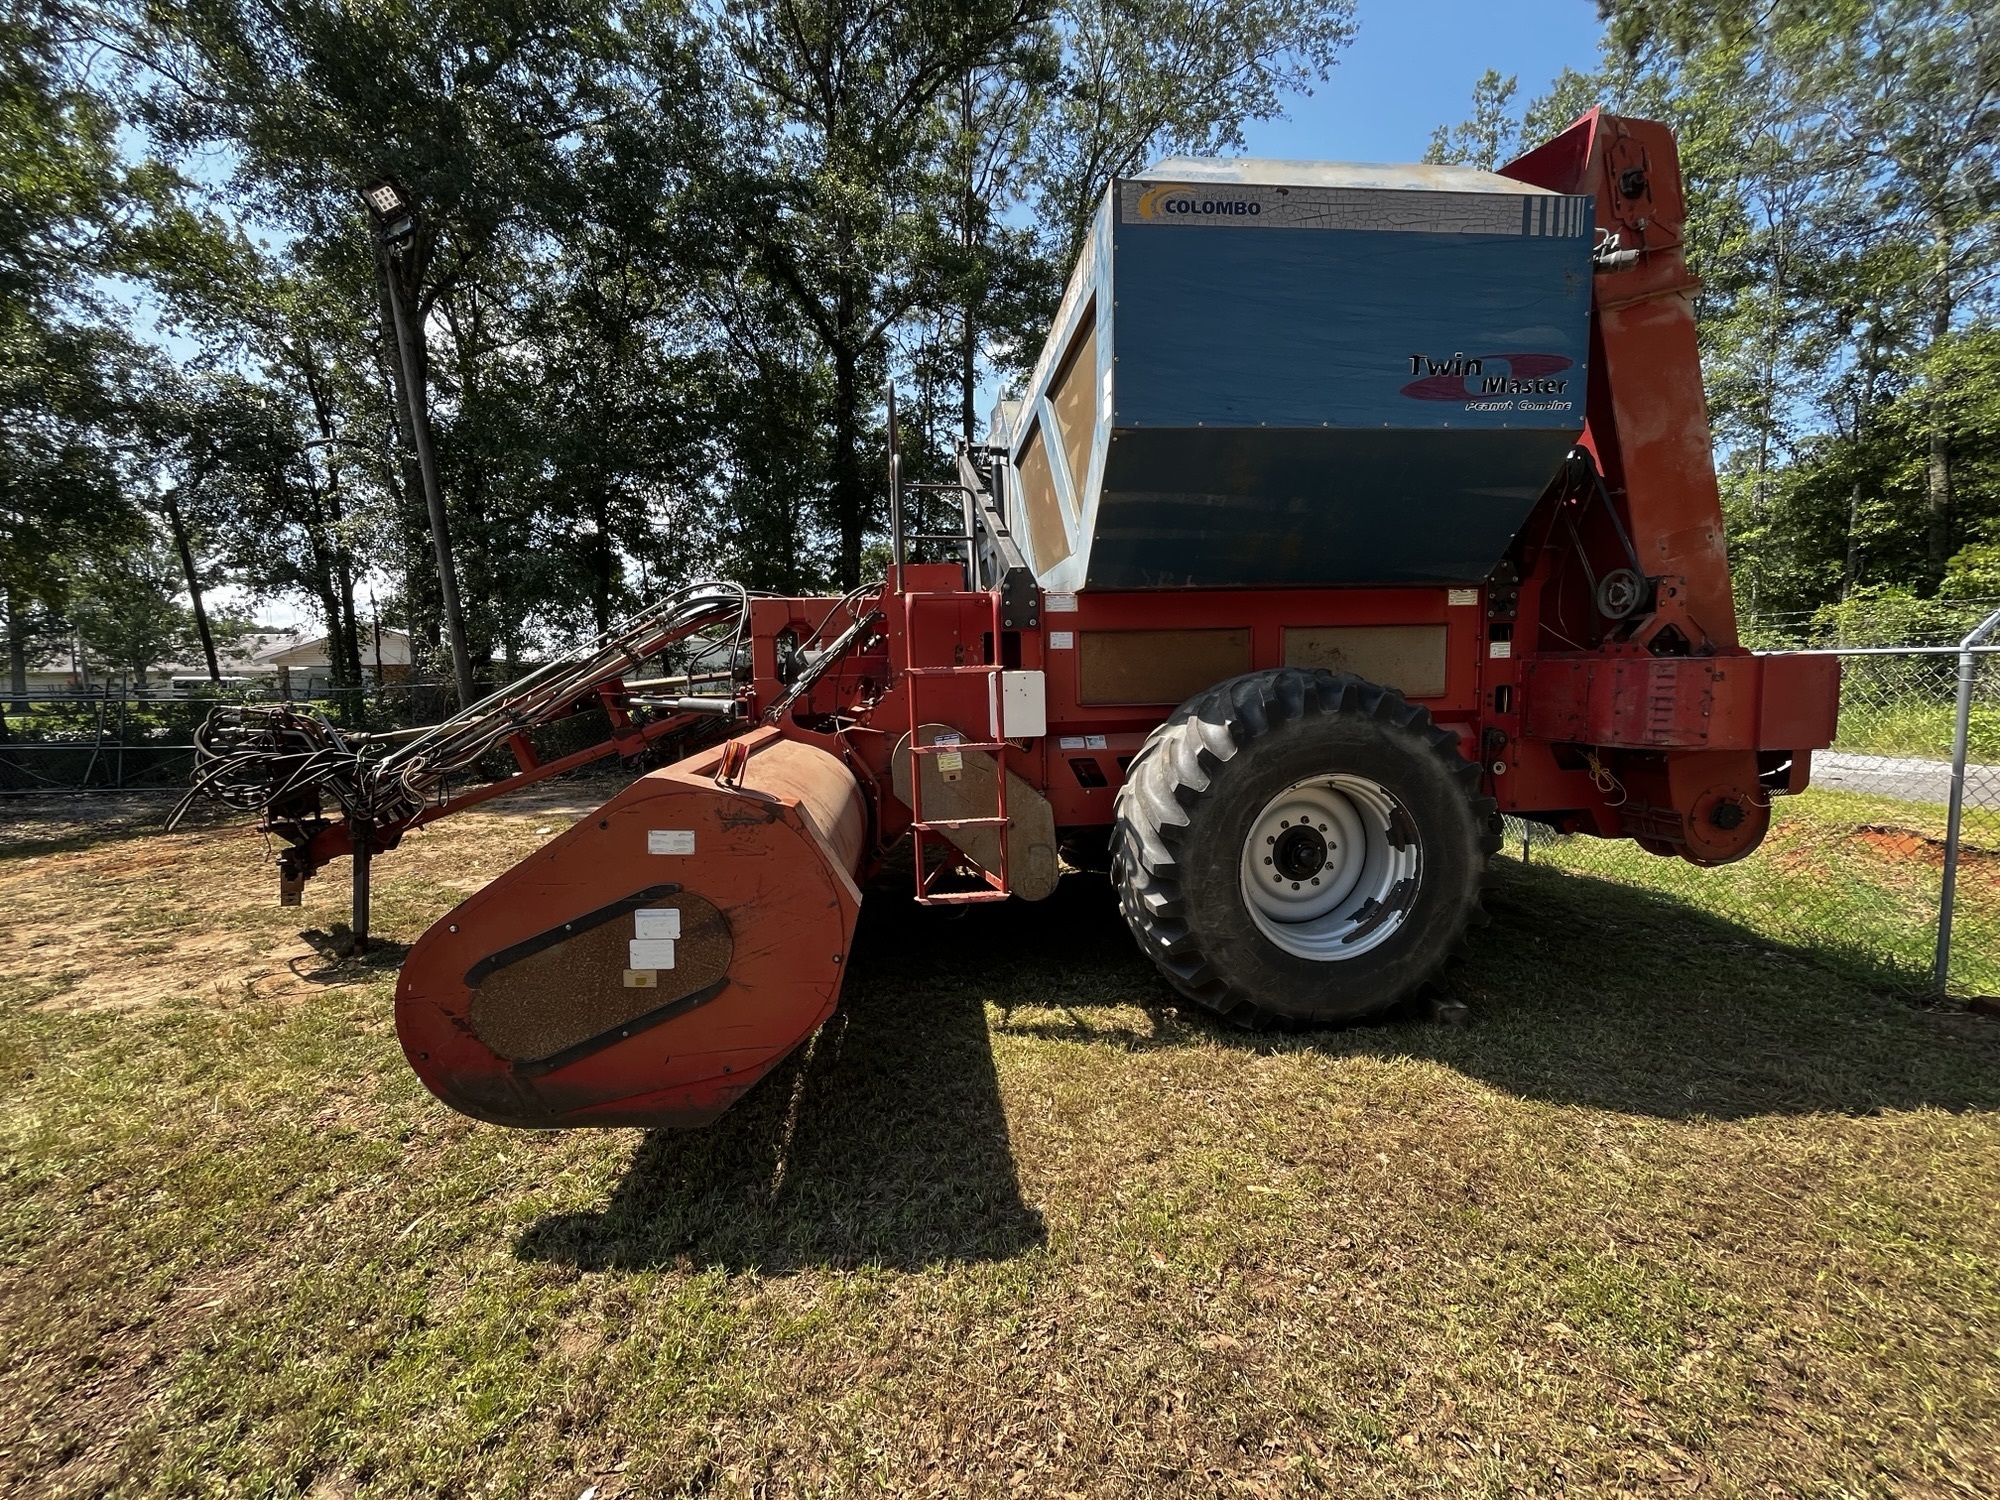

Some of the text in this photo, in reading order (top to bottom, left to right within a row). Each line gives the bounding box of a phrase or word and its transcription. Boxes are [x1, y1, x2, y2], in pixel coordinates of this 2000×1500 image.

[1165, 200, 1261, 216] COLOMBO
[1408, 352, 1483, 377] Twin
[1481, 375, 1568, 394] Master
[1464, 400, 1572, 411] Peanut Combine
